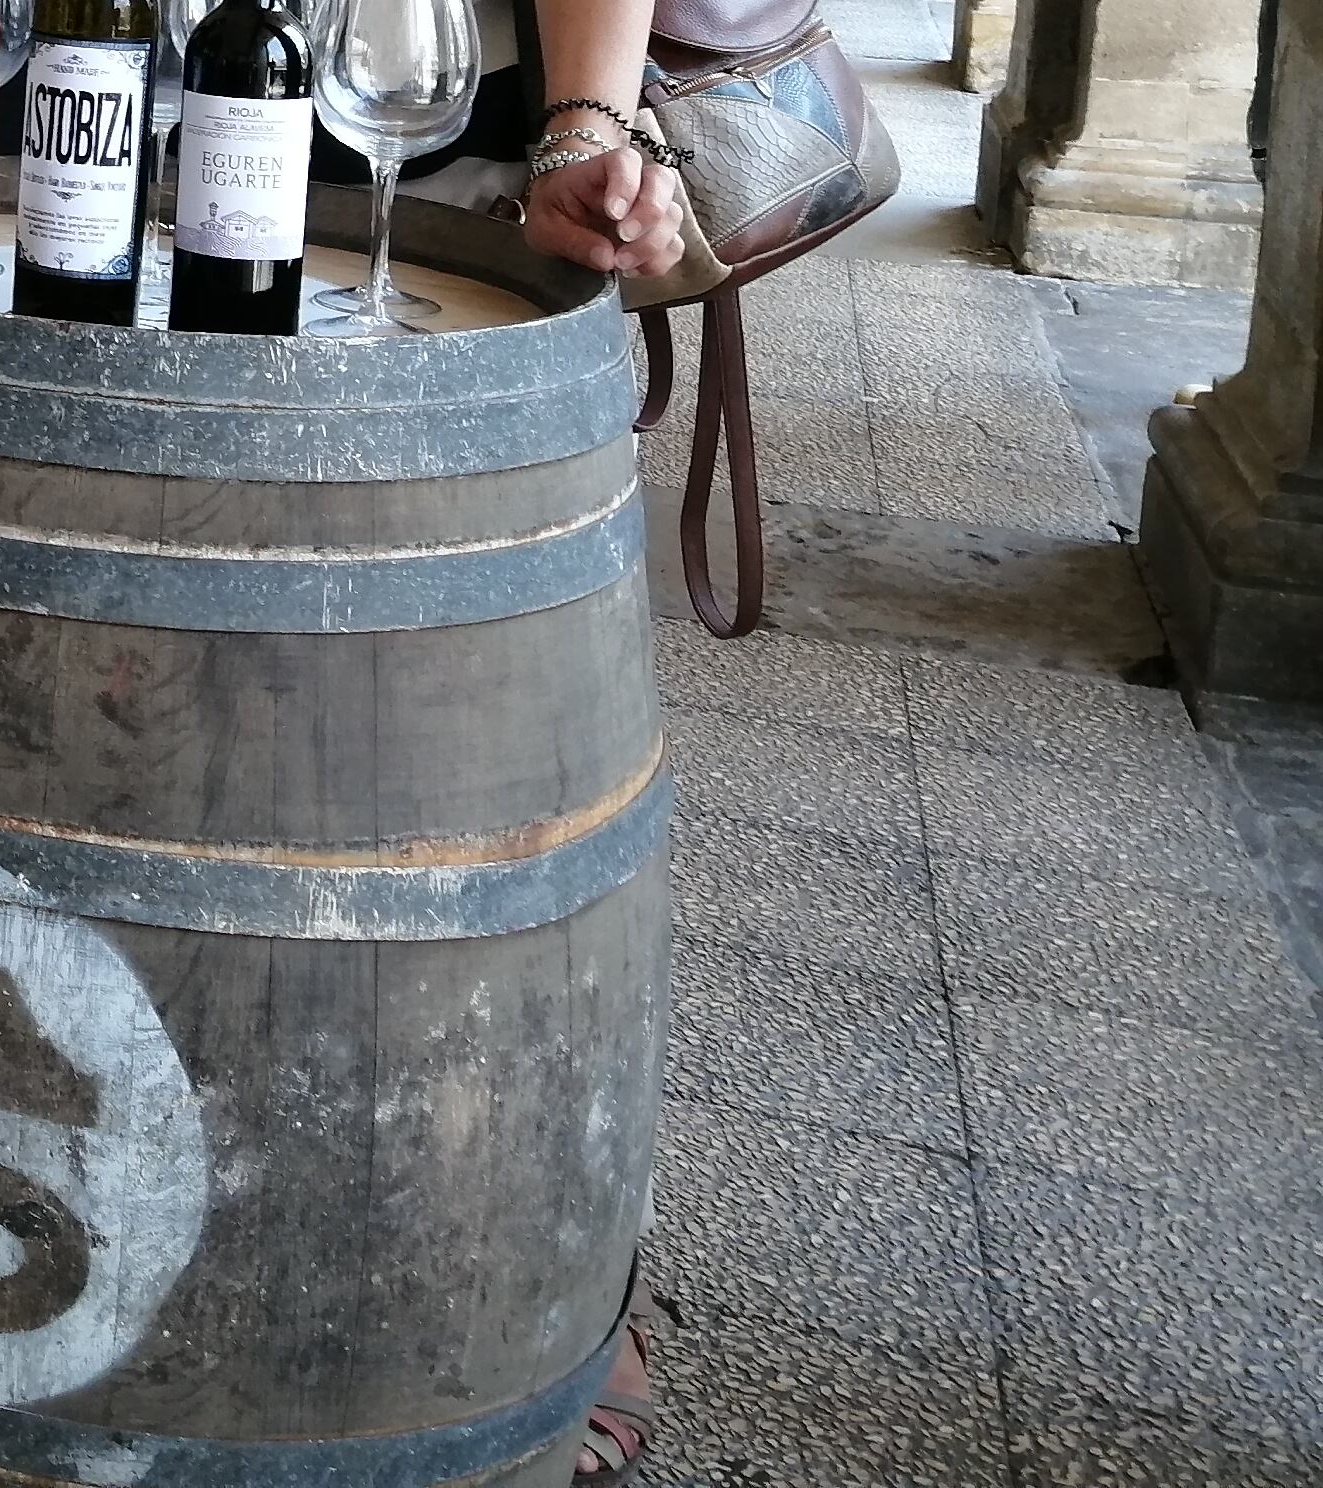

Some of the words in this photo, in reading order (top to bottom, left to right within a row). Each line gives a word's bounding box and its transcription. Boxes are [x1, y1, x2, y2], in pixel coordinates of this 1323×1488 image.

[228, 106, 264, 118] RIOJA
[23, 81, 134, 168] ASTOBIZA
[201, 150, 283, 172] EGUREN
[201, 168, 283, 189] UGARTE
